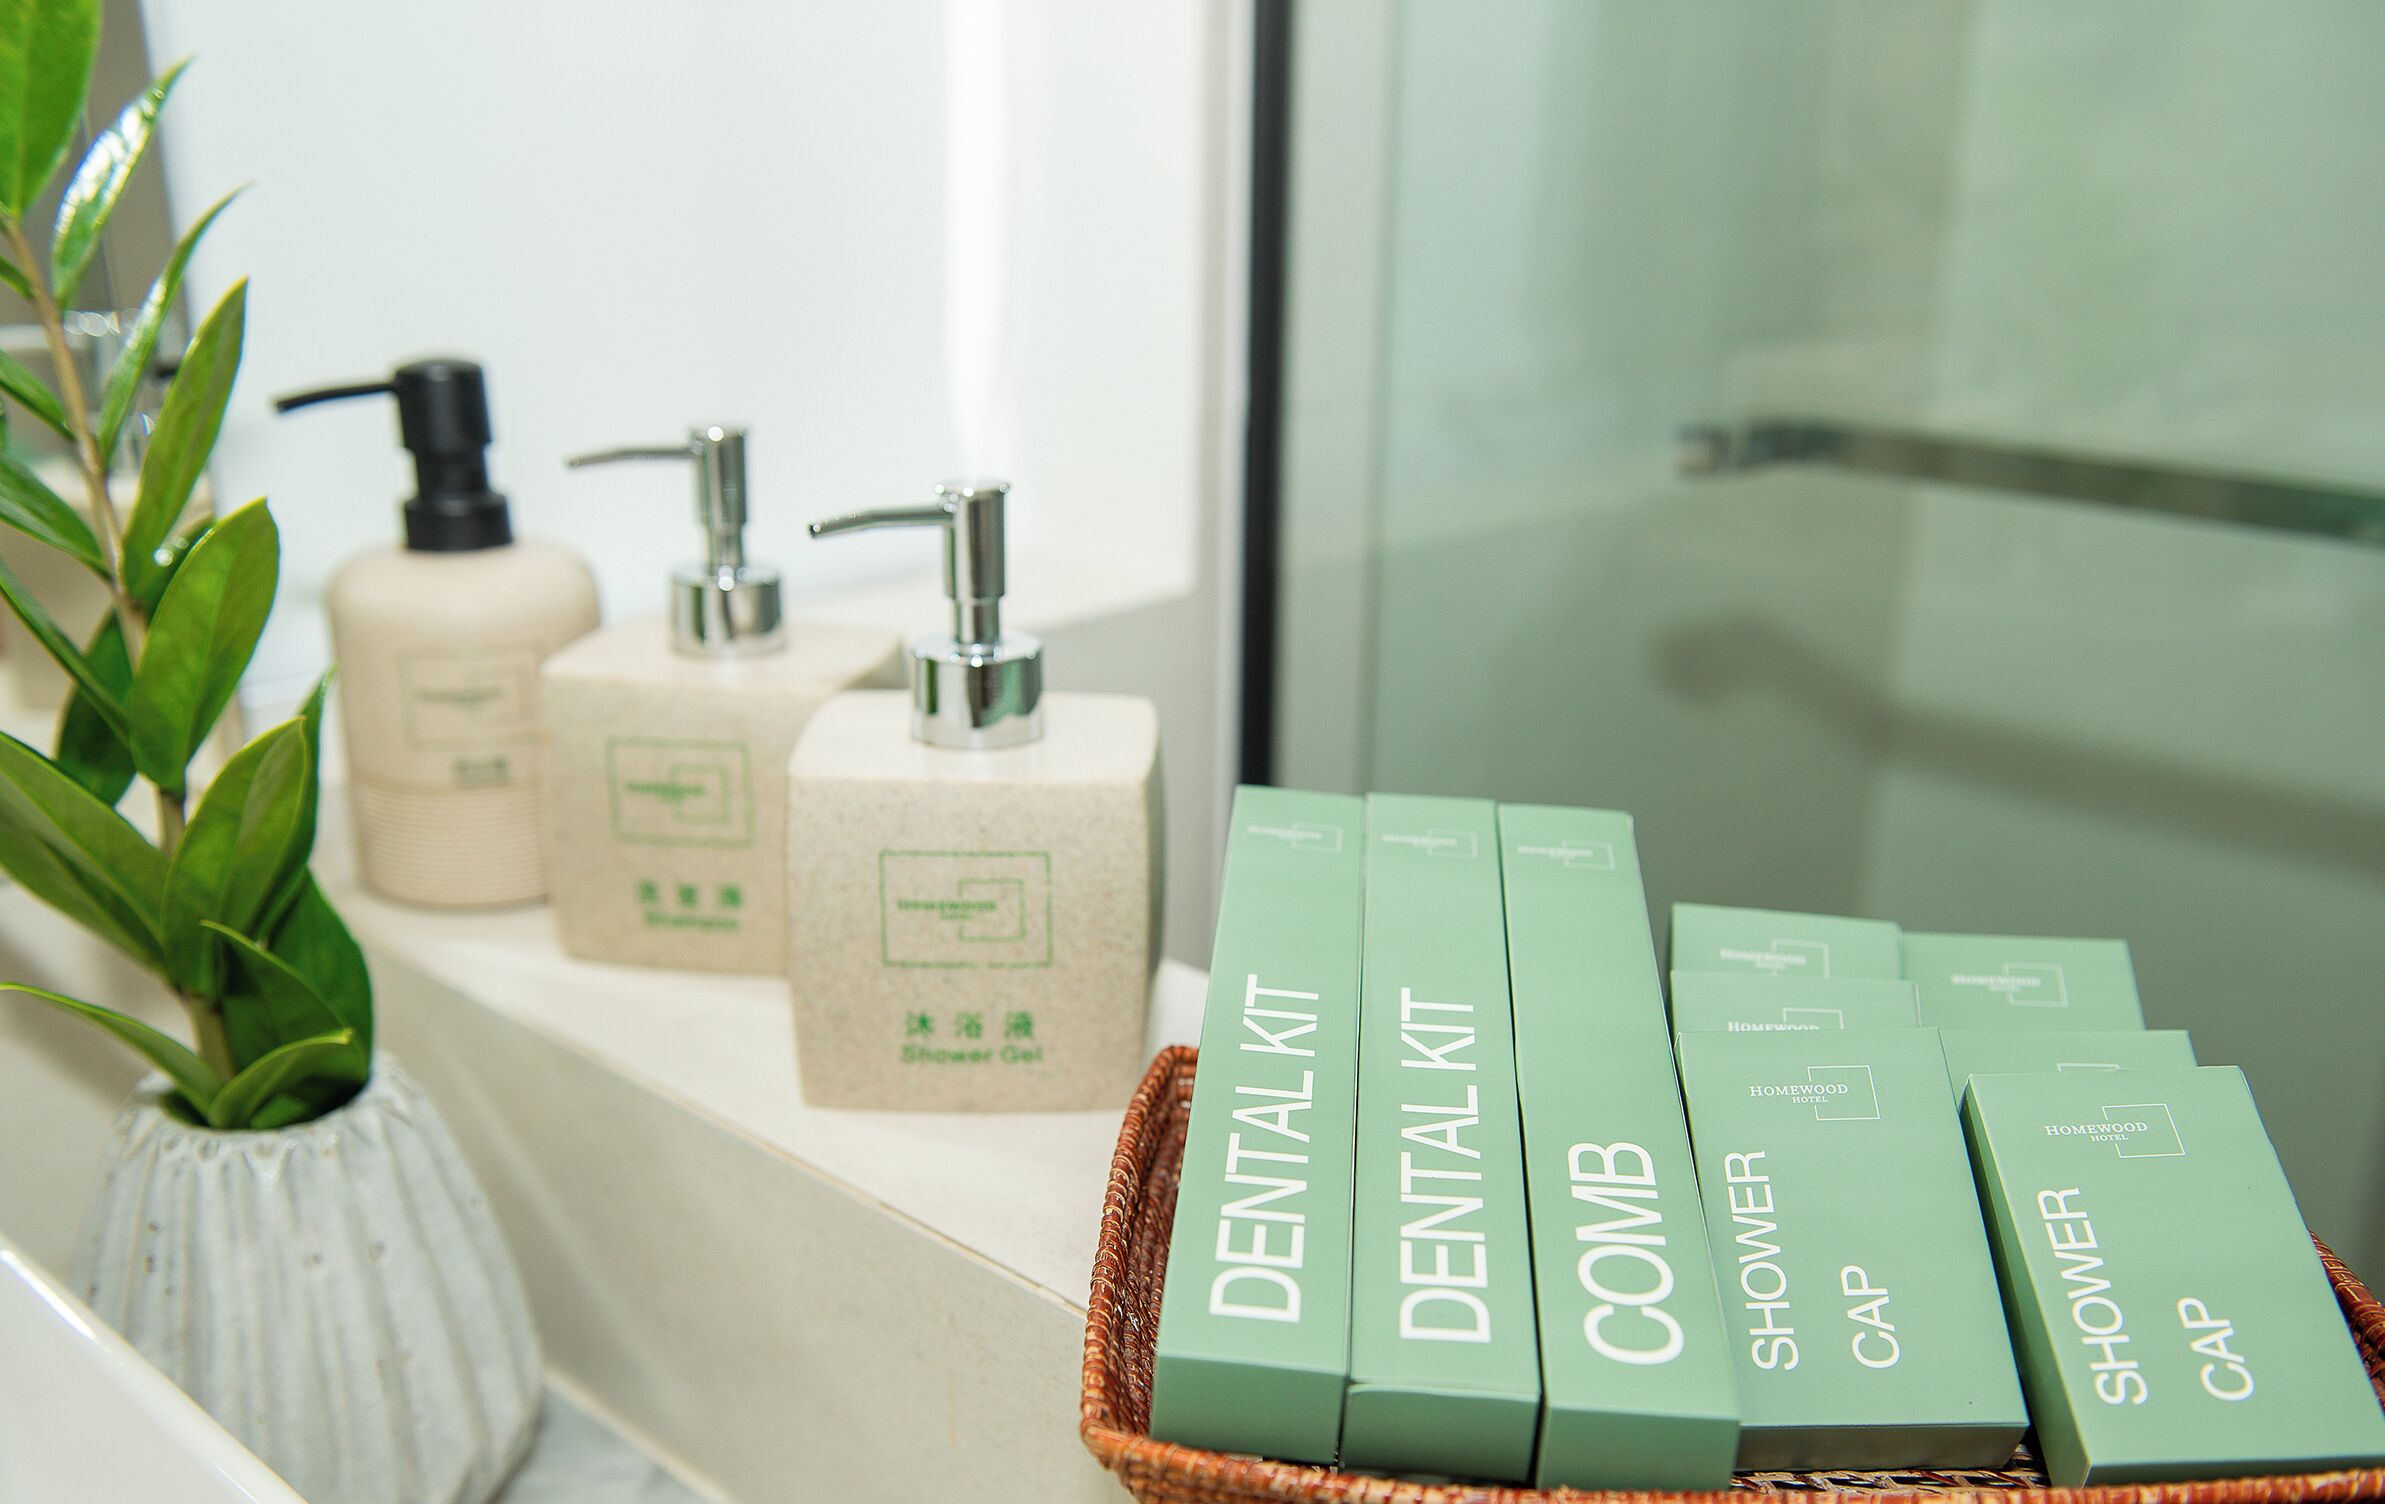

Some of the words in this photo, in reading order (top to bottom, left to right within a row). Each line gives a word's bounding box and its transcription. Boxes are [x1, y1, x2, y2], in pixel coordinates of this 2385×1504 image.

[901, 1044, 994, 1064] Shower
[1000, 1044, 1044, 1065] Gel
[1239, 973, 1320, 1058] KIT
[1400, 986, 1477, 1072] KIT
[1749, 1083, 1849, 1097] HOMEWOOD
[1792, 1095, 1829, 1104] HOTEL
[2044, 1121, 2149, 1136] HOMEWOOD
[2090, 1133, 2129, 1142] HOTEL
[1208, 1070, 1315, 1324] DENTAL
[1399, 1084, 1492, 1344] DENTAL
[1566, 1141, 1686, 1366] COMB
[1723, 1149, 1800, 1371] SHOWER
[2036, 1186, 2149, 1406] SHOWER
[1840, 1264, 1901, 1370] CAP
[2176, 1296, 2255, 1402] CAP
